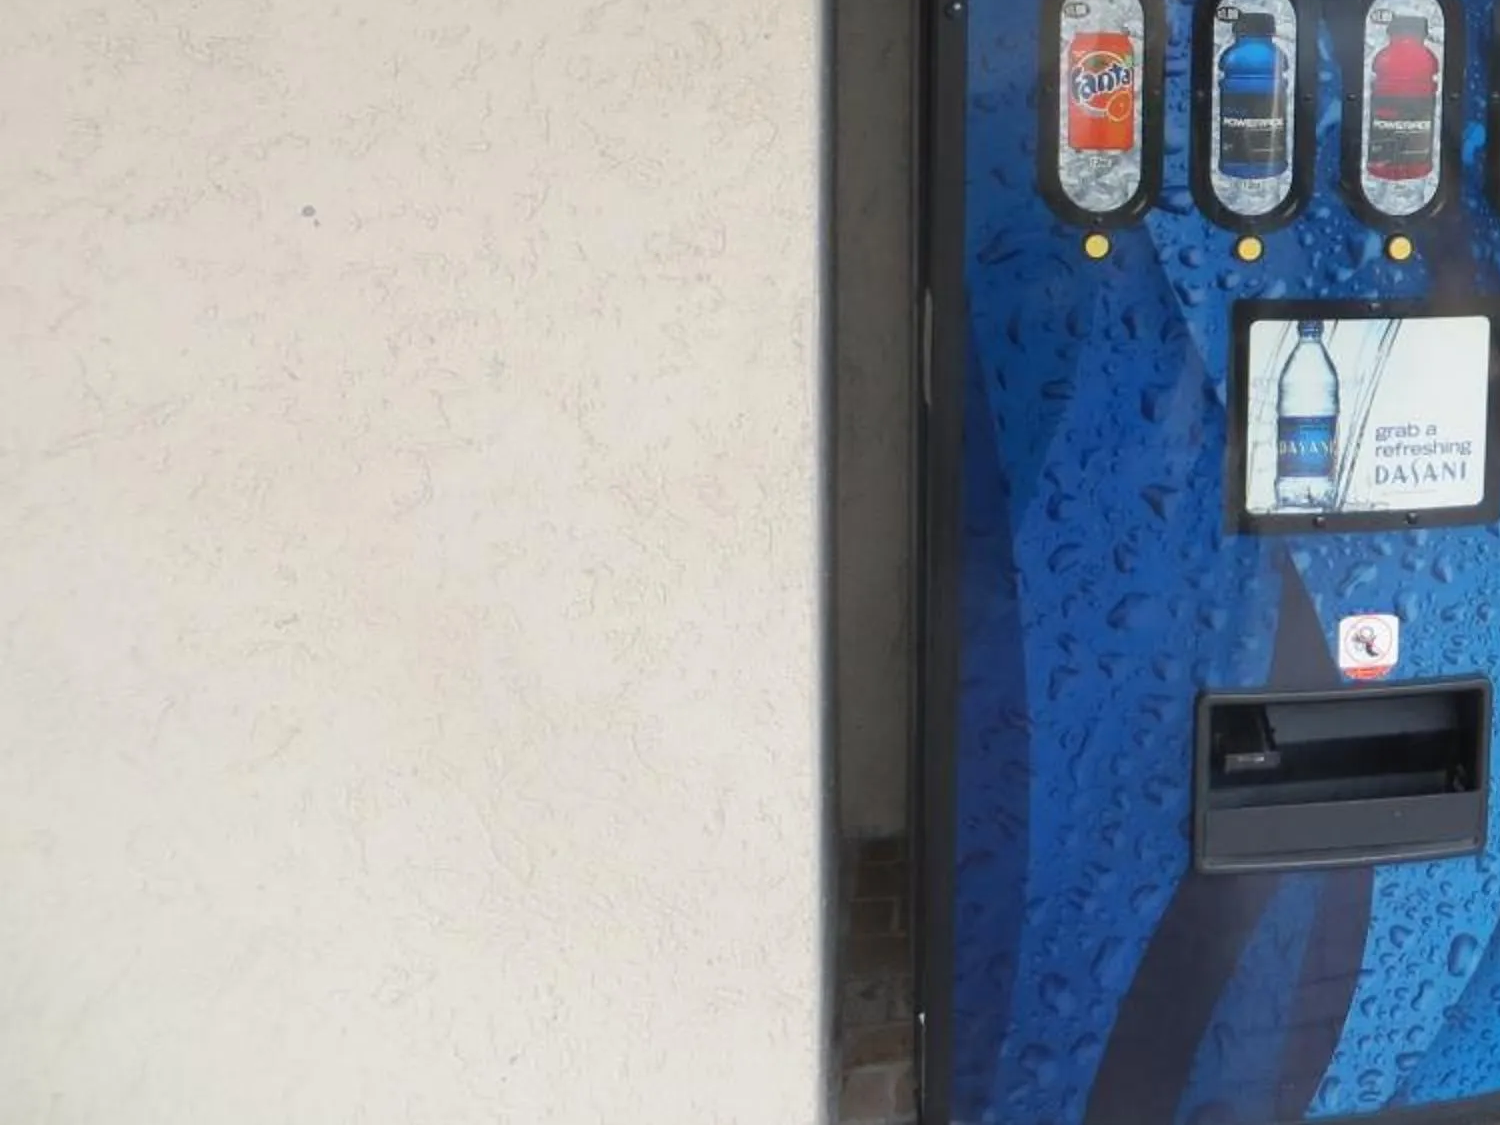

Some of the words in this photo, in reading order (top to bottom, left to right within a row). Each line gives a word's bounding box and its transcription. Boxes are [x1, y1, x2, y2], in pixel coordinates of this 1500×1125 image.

[1071, 63, 1132, 106] Fanta
[1375, 423, 1420, 442] grab
[1425, 425, 1437, 437] a
[1374, 438, 1472, 458] refreshing
[1374, 459, 1467, 487] DASANI
